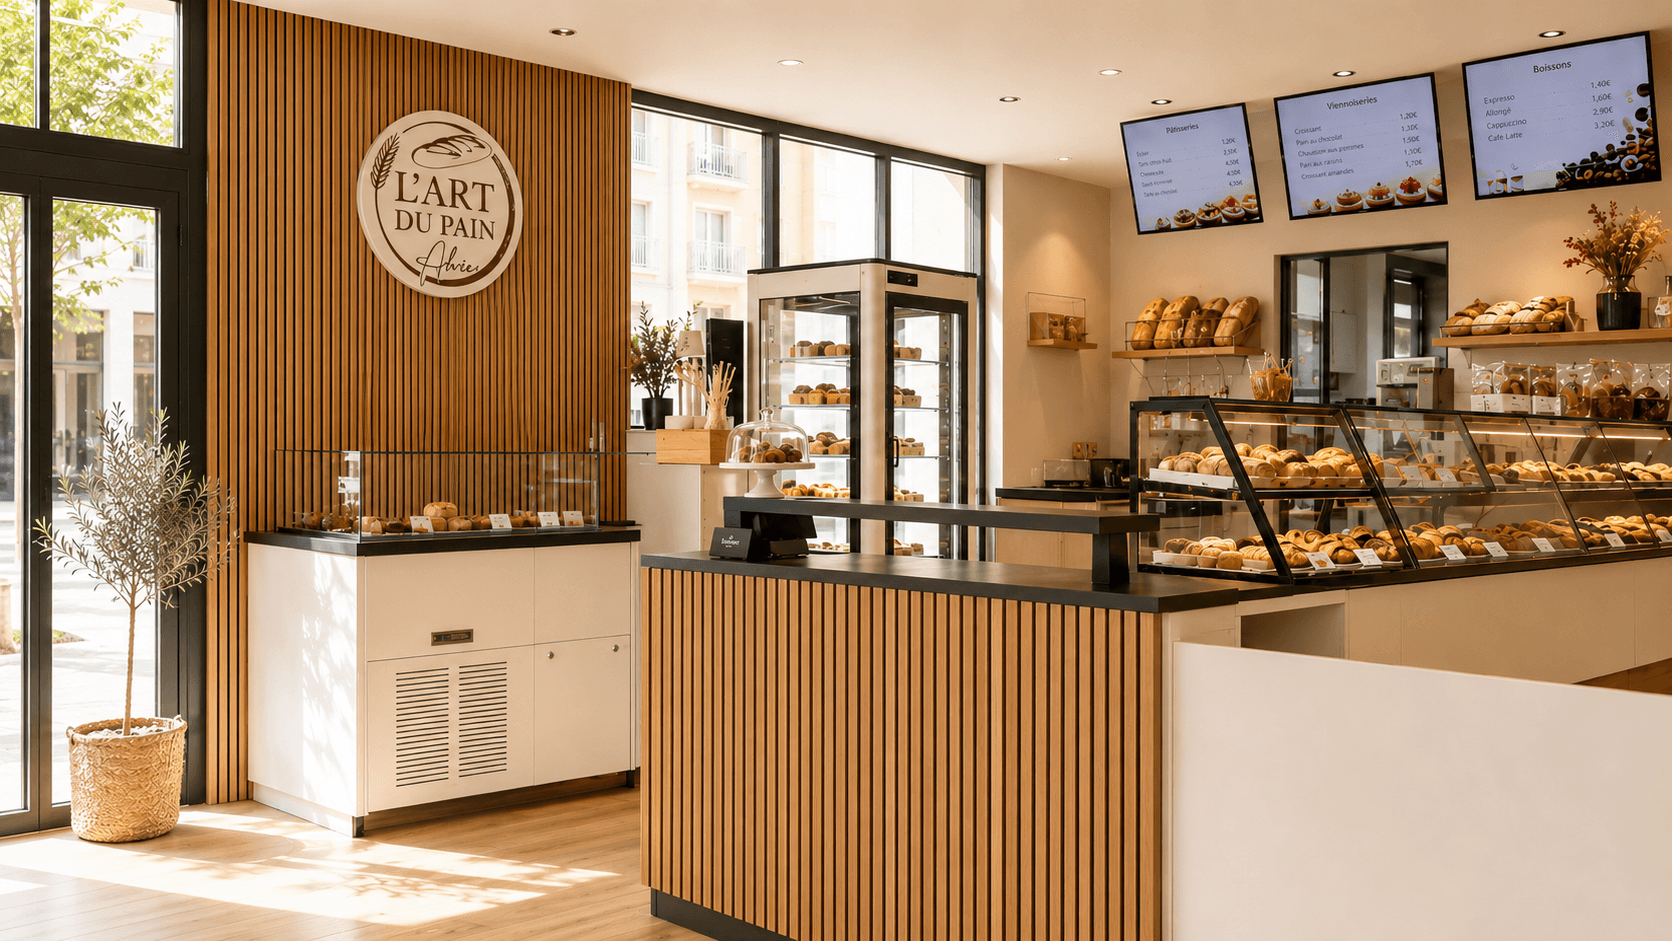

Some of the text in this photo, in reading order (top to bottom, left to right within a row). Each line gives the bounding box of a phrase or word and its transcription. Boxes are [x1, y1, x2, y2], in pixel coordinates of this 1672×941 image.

[1533, 61, 1571, 73] Boissons
[1484, 80, 1611, 105] Expresso 1,40€
[1327, 96, 1378, 110] Viennoiseries
[1486, 93, 1612, 117] Allongé 1,60€
[1166, 123, 1199, 134] Pâtisseries
[1487, 118, 1527, 129] Cappuccino
[1506, 132, 1522, 140] Latte
[395, 171, 494, 212] L’ART
[395, 209, 496, 240] DU PAIN
